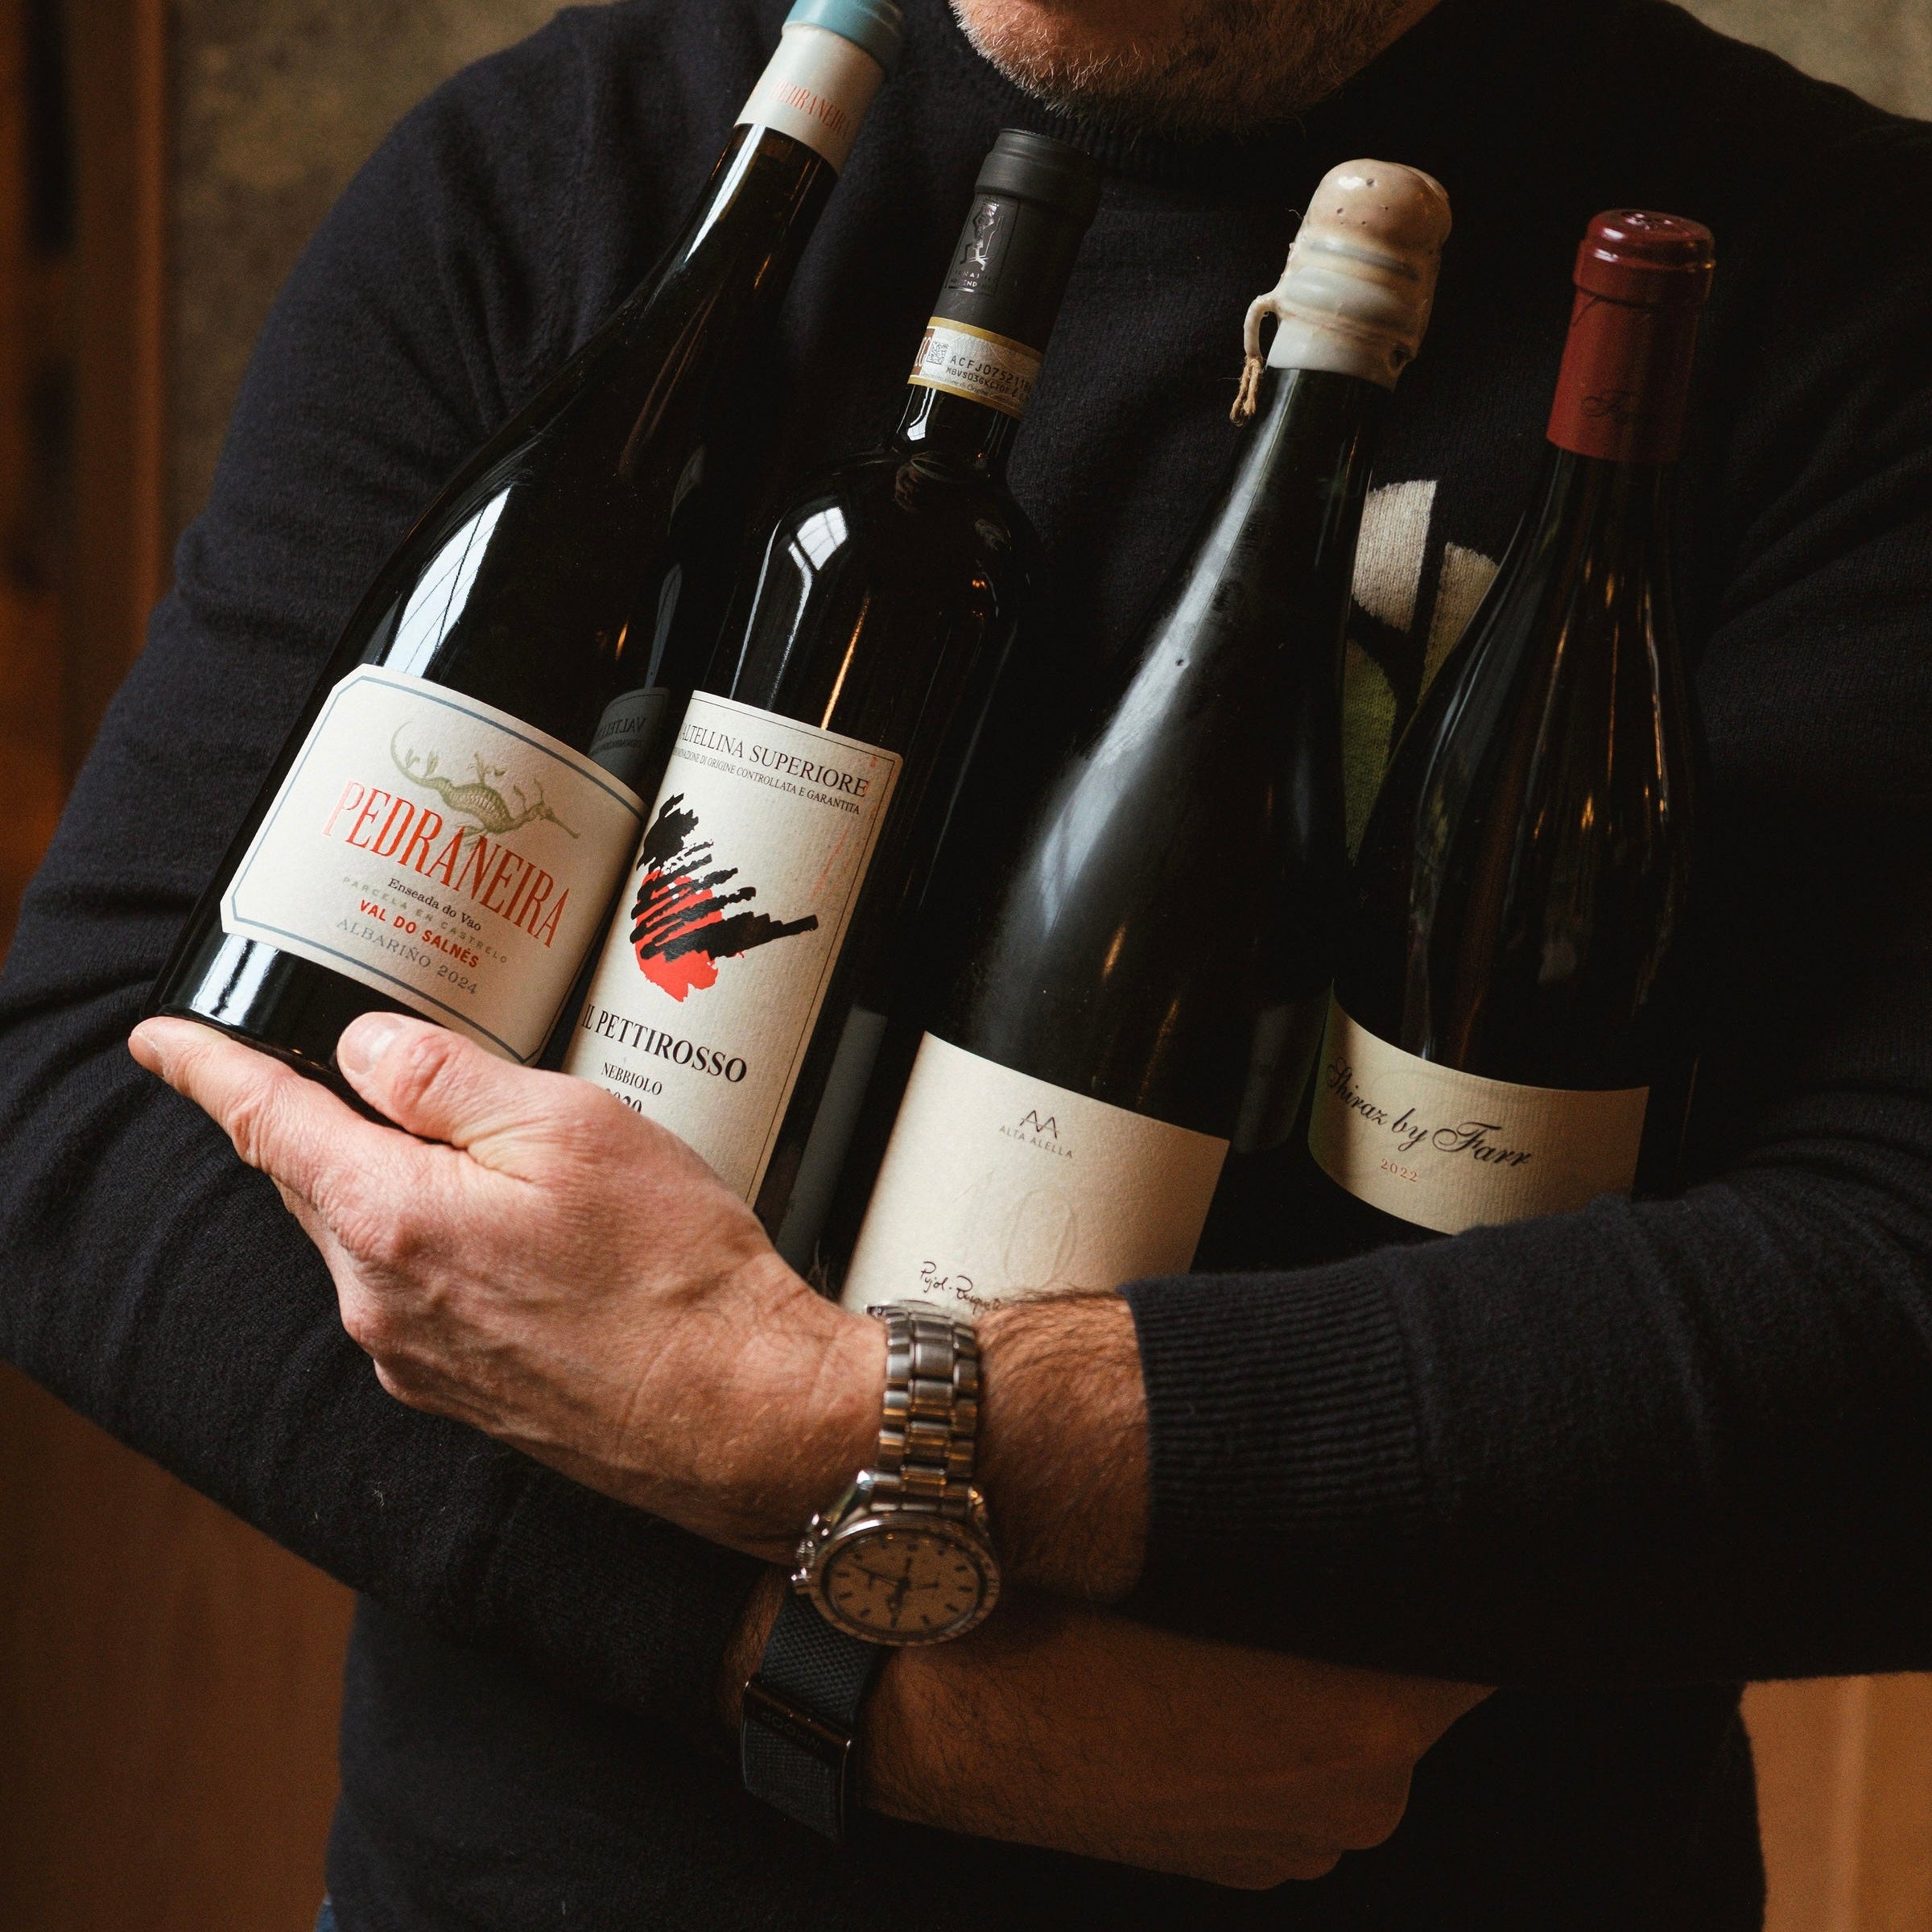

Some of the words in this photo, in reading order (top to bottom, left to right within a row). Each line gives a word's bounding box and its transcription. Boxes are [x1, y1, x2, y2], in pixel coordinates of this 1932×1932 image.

[708, 757, 736, 774] ORIGINE
[736, 767, 797, 795] CONTROLLATA
[799, 786, 806, 797] E
[807, 789, 861, 815] GARANTITA
[749, 745, 870, 797] SUPERIORE
[322, 779, 570, 948] PEDRANEIRA
[343, 877, 407, 910] PARCELA
[415, 909, 433, 923] EN
[440, 921, 507, 964] CASTRELO
[360, 899, 386, 922] VAL
[393, 915, 417, 934] DO
[422, 930, 480, 968] SALNÉS
[387, 877, 440, 910] Enseada
[442, 903, 457, 919] do
[460, 911, 482, 931] Vao
[336, 919, 431, 968] ALBARIÑO
[436, 965, 477, 995] 2024
[581, 1004, 595, 1030] IL
[596, 1009, 748, 1084] PETTIROSSO
[601, 1062, 663, 1096] NEBBIOLO
[998, 1125, 1026, 1141] ALTA
[1030, 1135, 1075, 1159] ALELLA
[1324, 1056, 1388, 1126] Shiraz
[1391, 1108, 1427, 1151] by
[1432, 1121, 1533, 1167] Farr
[1380, 1158, 1418, 1183] 2022
